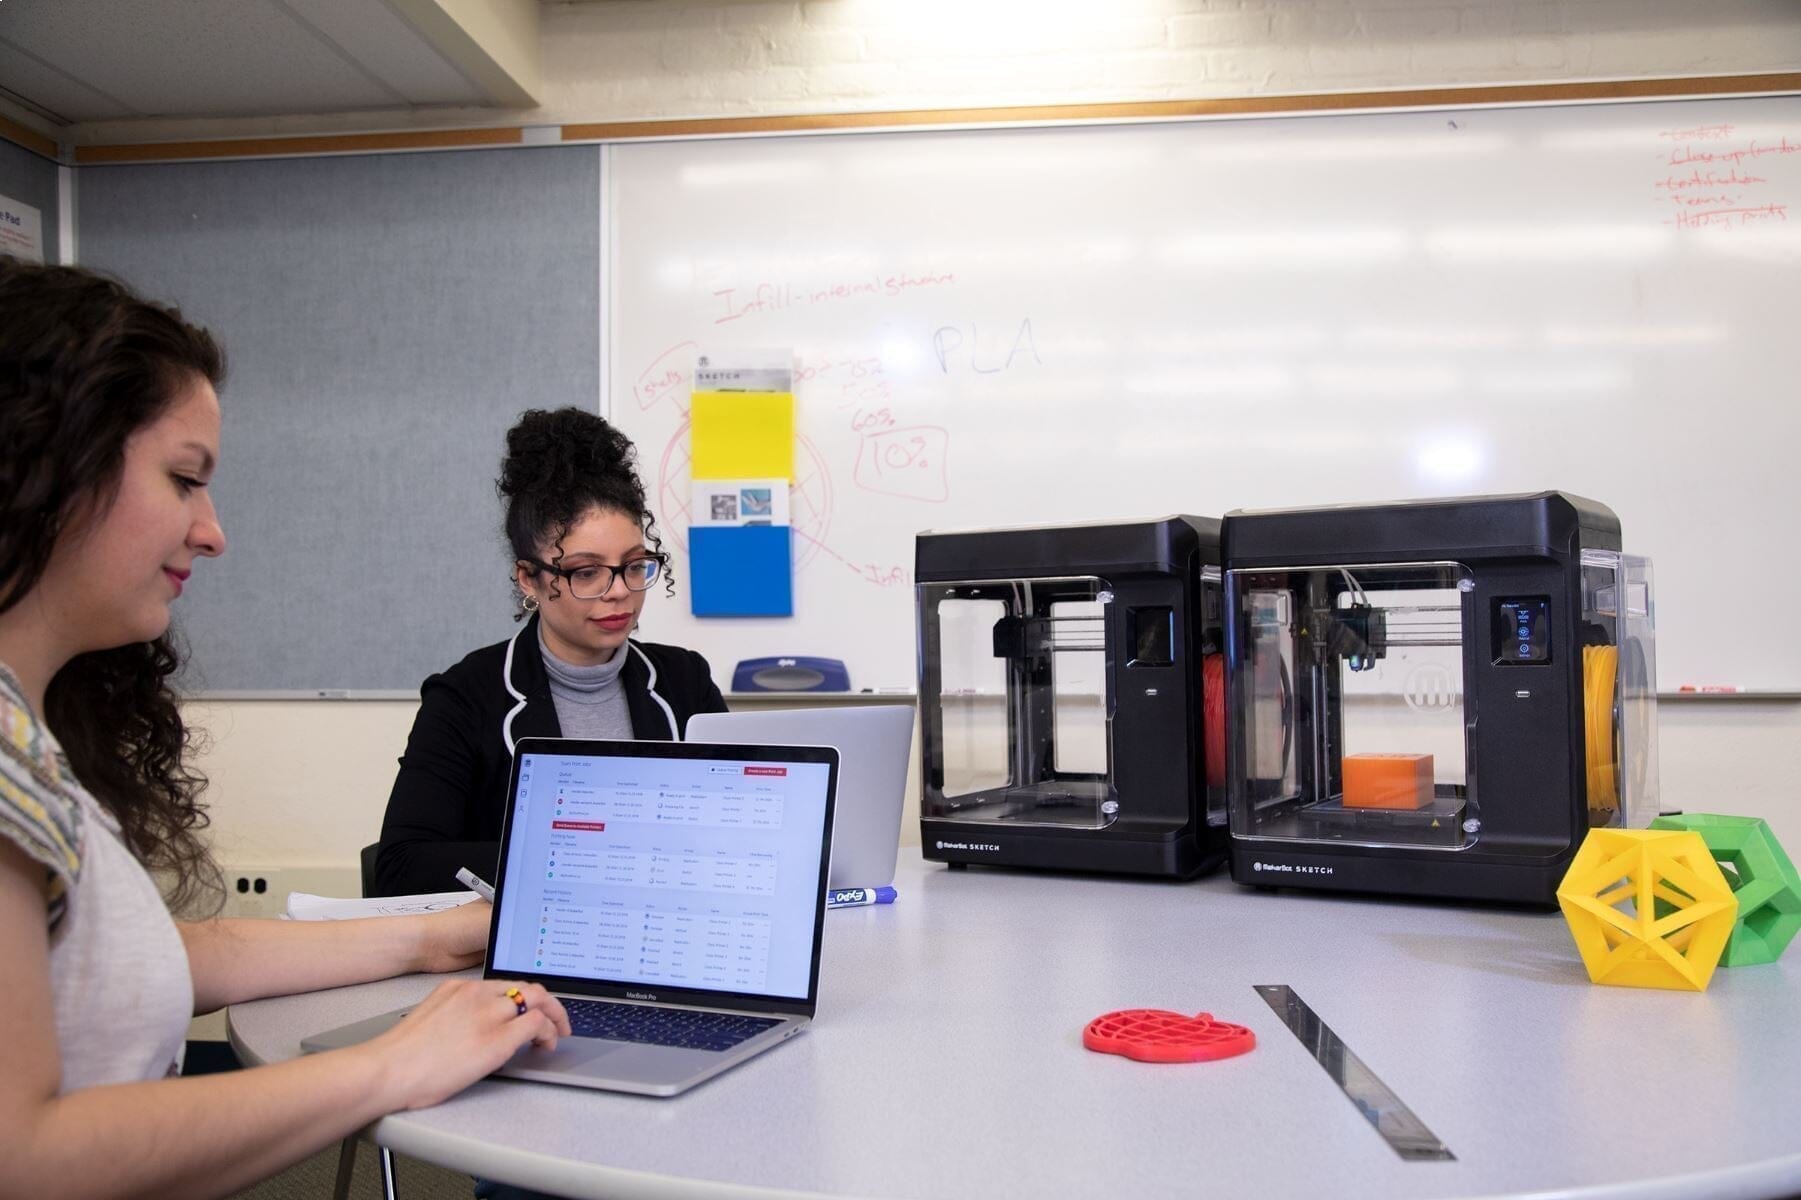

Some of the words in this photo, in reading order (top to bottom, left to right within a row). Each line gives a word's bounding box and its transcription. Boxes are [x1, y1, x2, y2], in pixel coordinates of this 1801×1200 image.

[933, 317, 1043, 375] PLA
[698, 372, 741, 380] SKETCH
[969, 843, 1000, 851] SKETCH
[1295, 865, 1334, 874] SKETCH
[836, 889, 865, 902] EXPO
[648, 993, 657, 1001] Pro
